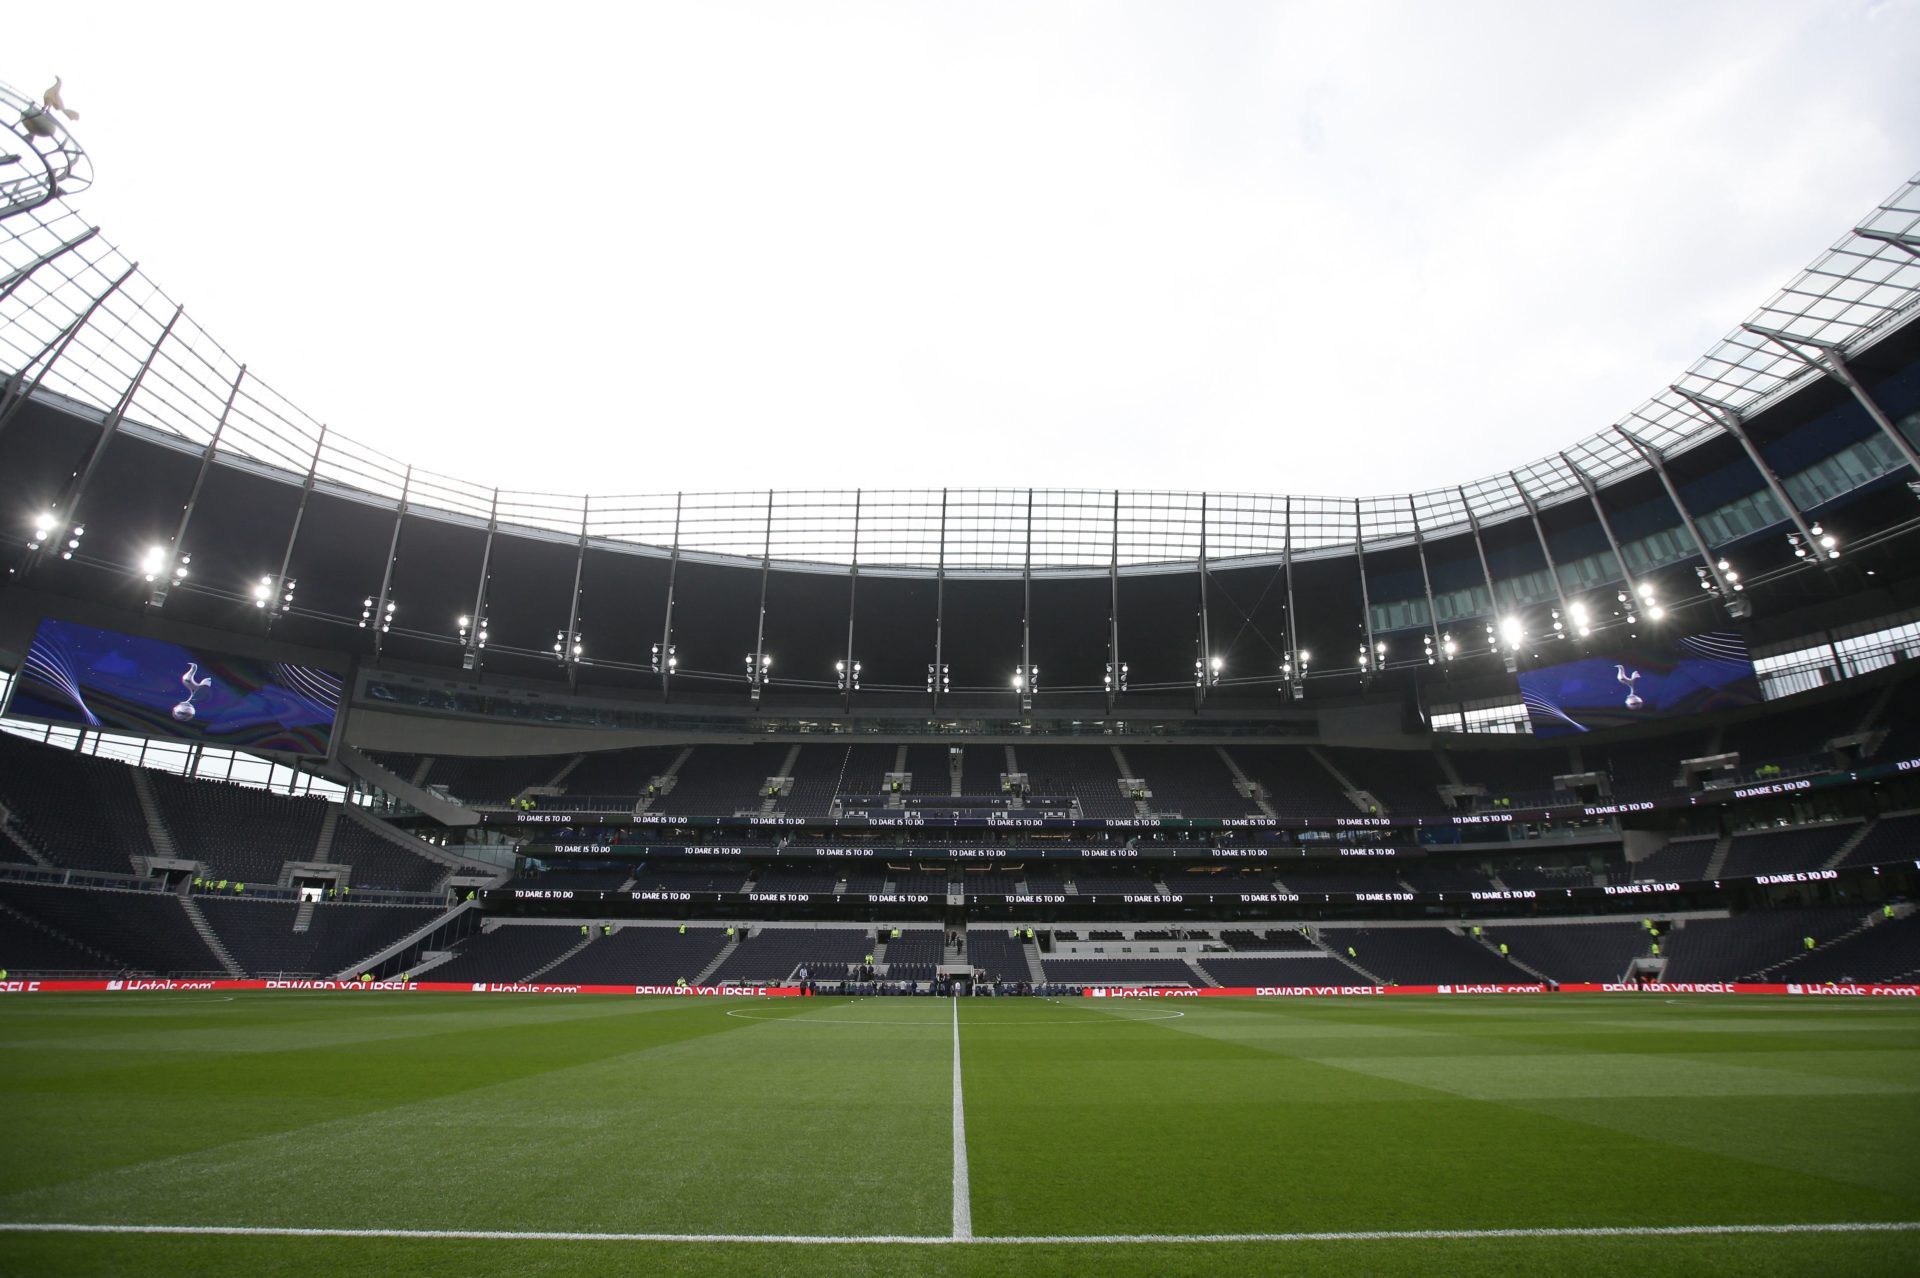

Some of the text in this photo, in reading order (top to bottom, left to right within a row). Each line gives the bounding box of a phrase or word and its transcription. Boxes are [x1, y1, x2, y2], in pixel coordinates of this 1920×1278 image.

[1896, 761, 1910, 770] TO
[1734, 790, 1747, 798] TO
[1747, 786, 1772, 796] DARE
[1772, 784, 1783, 793] IS
[1796, 780, 1810, 788] DO
[1596, 806, 1619, 814] DARE
[1628, 803, 1640, 811] TO
[1755, 870, 1837, 884] TO DARE IS TO DO
[1616, 885, 1642, 893] DARE
[1665, 883, 1680, 891] DO
[525, 890, 543, 898] DARE
[1523, 890, 1536, 898] DO
[127, 980, 212, 989] Hotelscom
[491, 983, 577, 993] Hotelscom
[1455, 984, 1541, 993] Hotelscom
[1111, 988, 1199, 997] Hotelscom
[1806, 984, 1917, 996] Hotelscom
